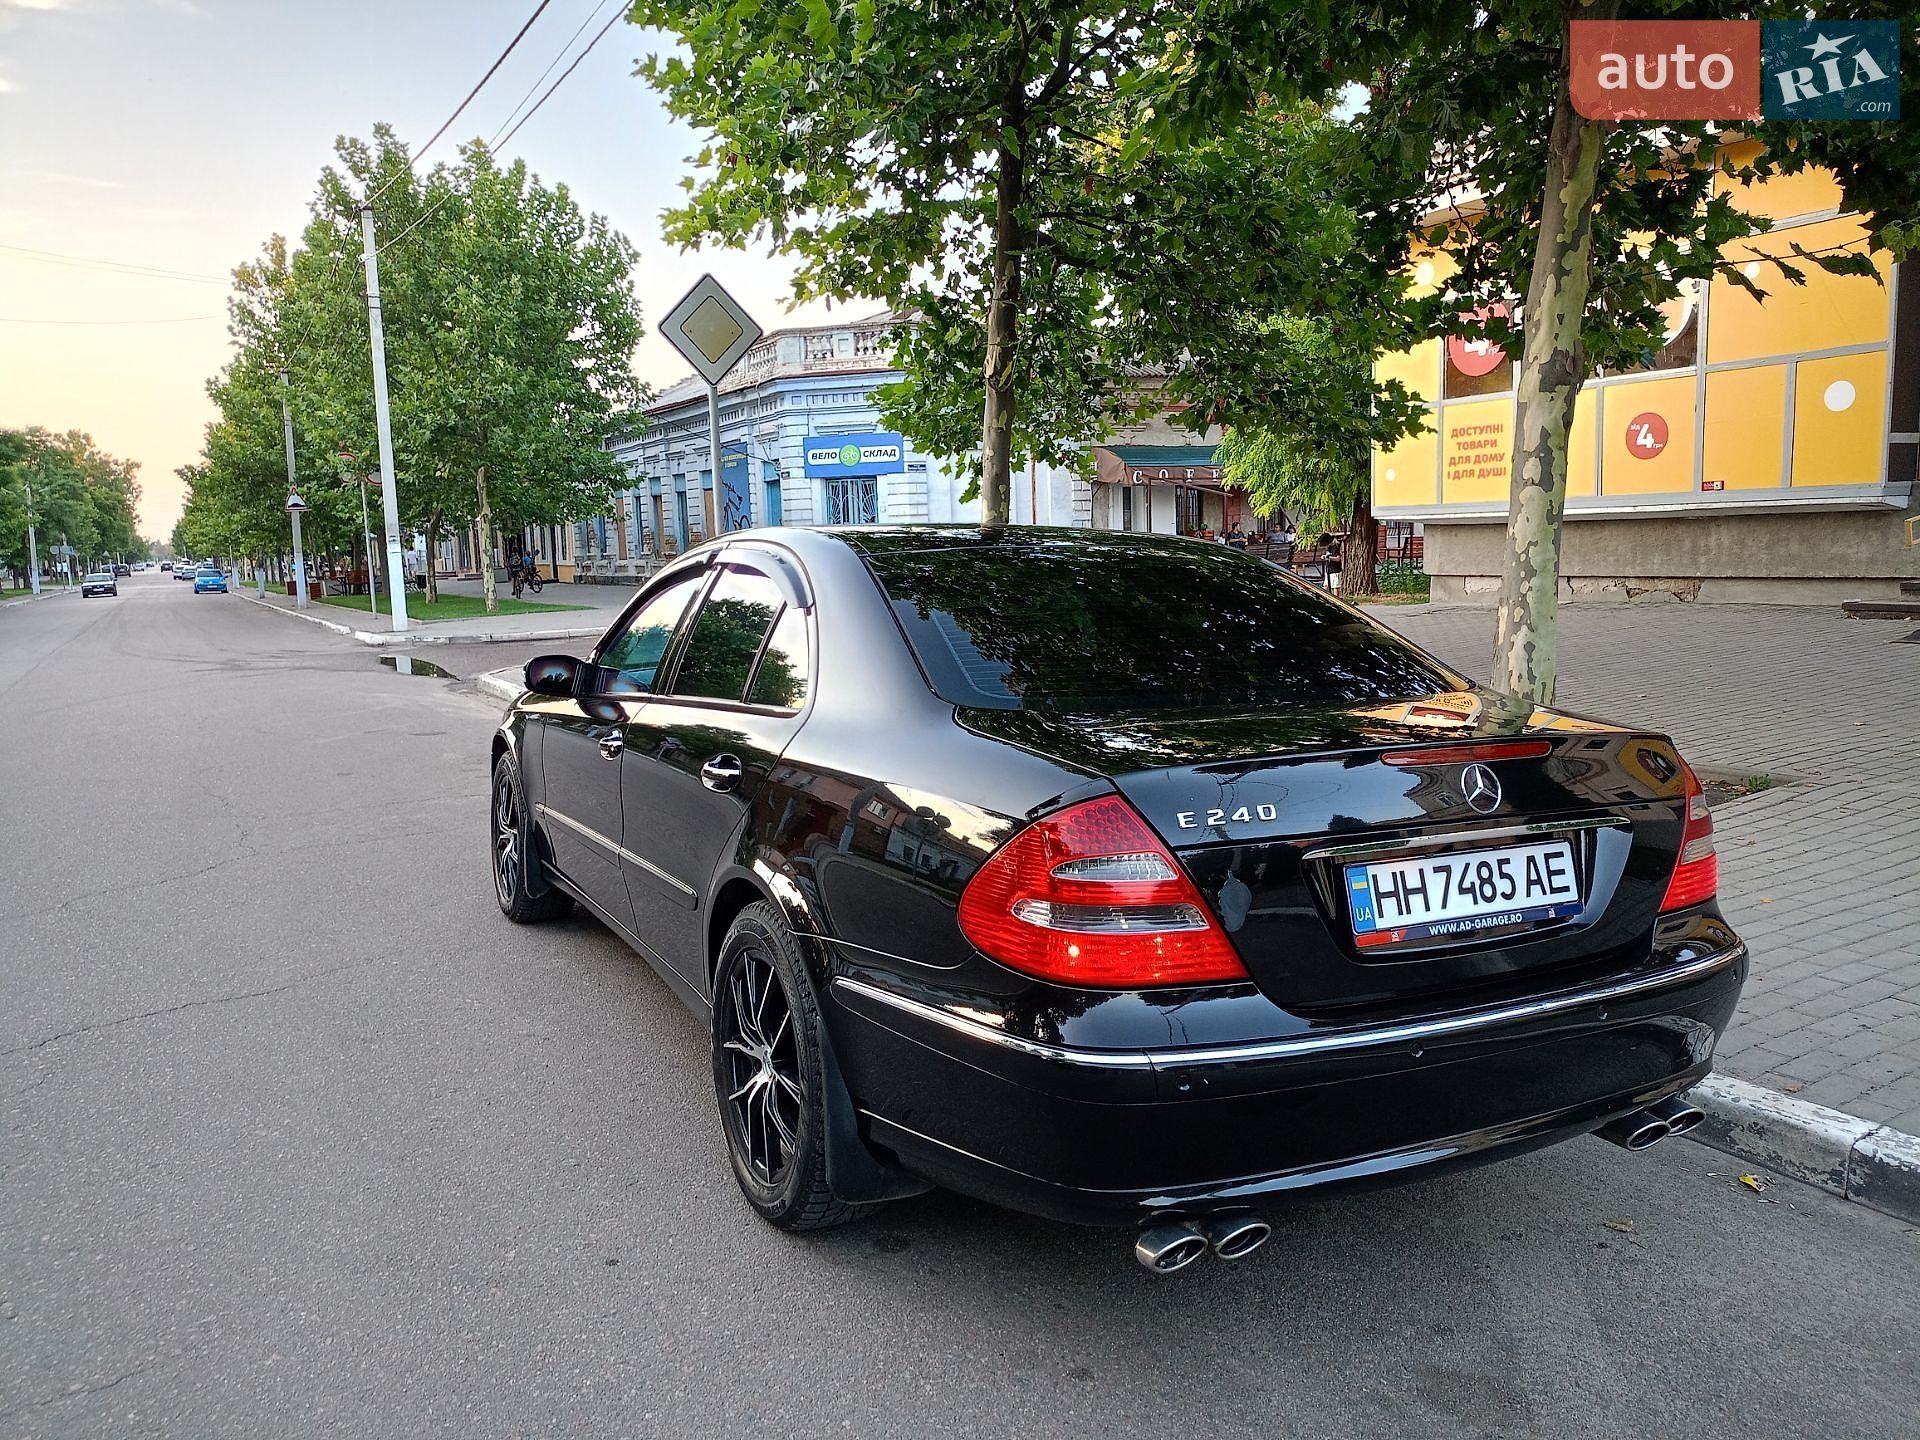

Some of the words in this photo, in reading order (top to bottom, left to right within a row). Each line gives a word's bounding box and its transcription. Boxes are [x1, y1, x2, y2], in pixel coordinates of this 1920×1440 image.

[1451, 423, 1503, 439] ДОСТУПНІ
[1636, 423, 1655, 449] 4
[1456, 439, 1498, 451] ТОВАРИ
[811, 452, 837, 460] ВЕЛО
[863, 448, 897, 458] СКЛАД
[1448, 455, 1471, 467] ДЛЯ
[1473, 452, 1505, 465] ДОМУ
[1452, 469, 1475, 480] ДЛЯ
[1477, 467, 1507, 479] ДУШІ
[1176, 811, 1199, 829] E
[1205, 803, 1278, 826] 240
[1355, 906, 1373, 922] UA
[1429, 913, 1523, 936] WWW.AD-GARAGE.RO
